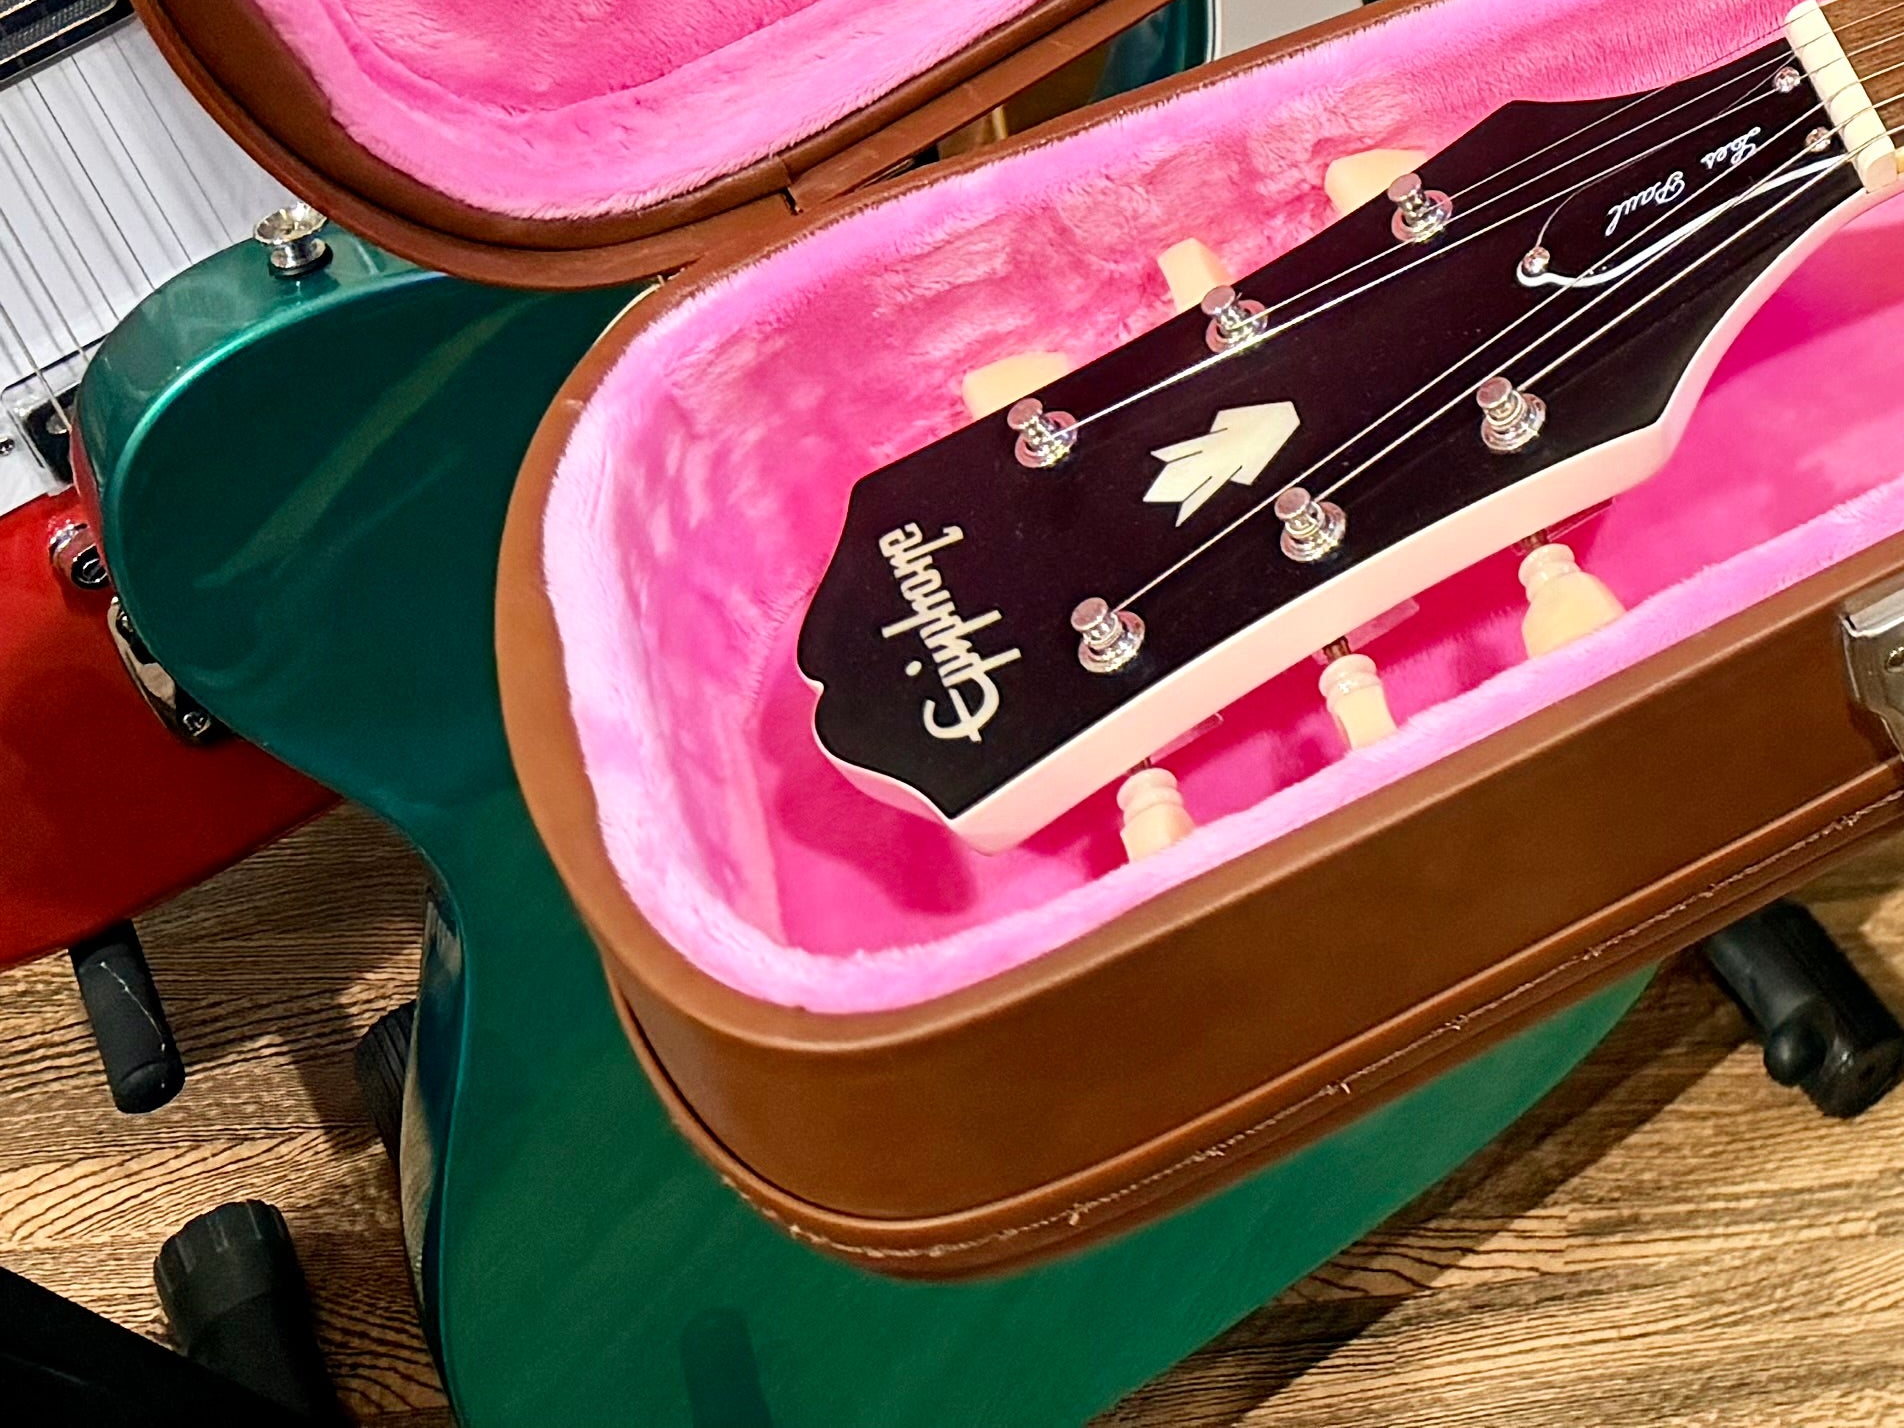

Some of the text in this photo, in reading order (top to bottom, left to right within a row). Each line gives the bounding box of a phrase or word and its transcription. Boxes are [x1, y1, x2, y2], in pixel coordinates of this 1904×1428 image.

[1604, 126, 1761, 237] Les Paul
[878, 522, 1022, 743] Epiphone
